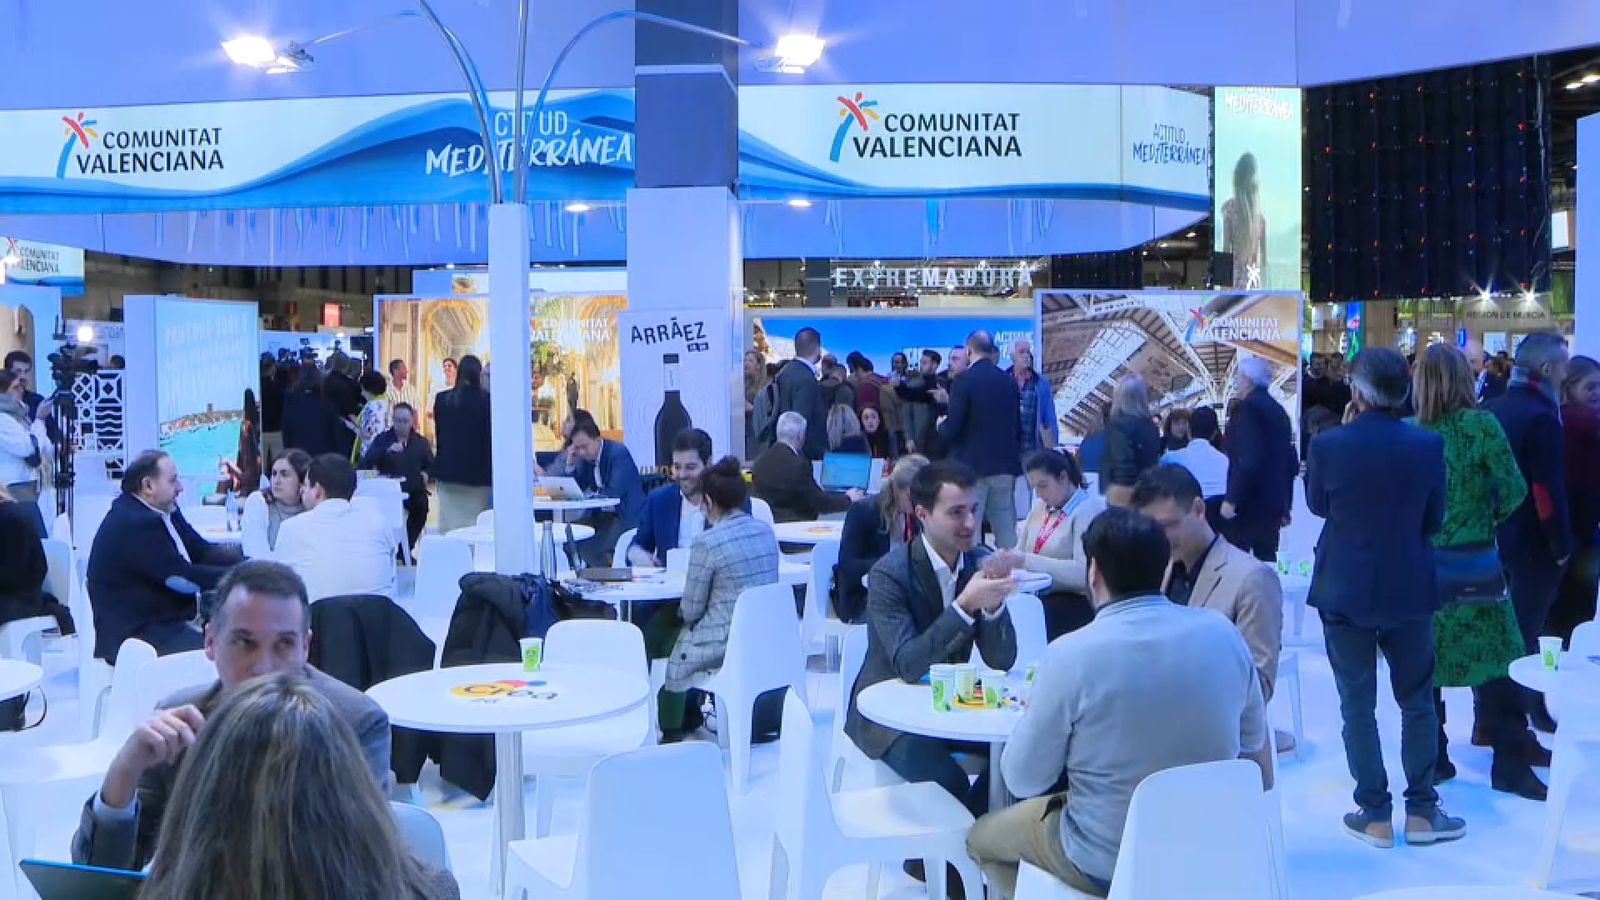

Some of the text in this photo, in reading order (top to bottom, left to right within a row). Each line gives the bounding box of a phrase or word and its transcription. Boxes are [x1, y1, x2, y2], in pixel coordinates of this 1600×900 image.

[884, 112, 1020, 132] COMUNITAT
[102, 127, 222, 150] COMUNITAT
[1153, 123, 1185, 144] ACTITUD
[853, 136, 1023, 158] VALENCIANA
[76, 149, 225, 175] VALENCIANA
[834, 266, 1034, 288] EXTREMADURA
